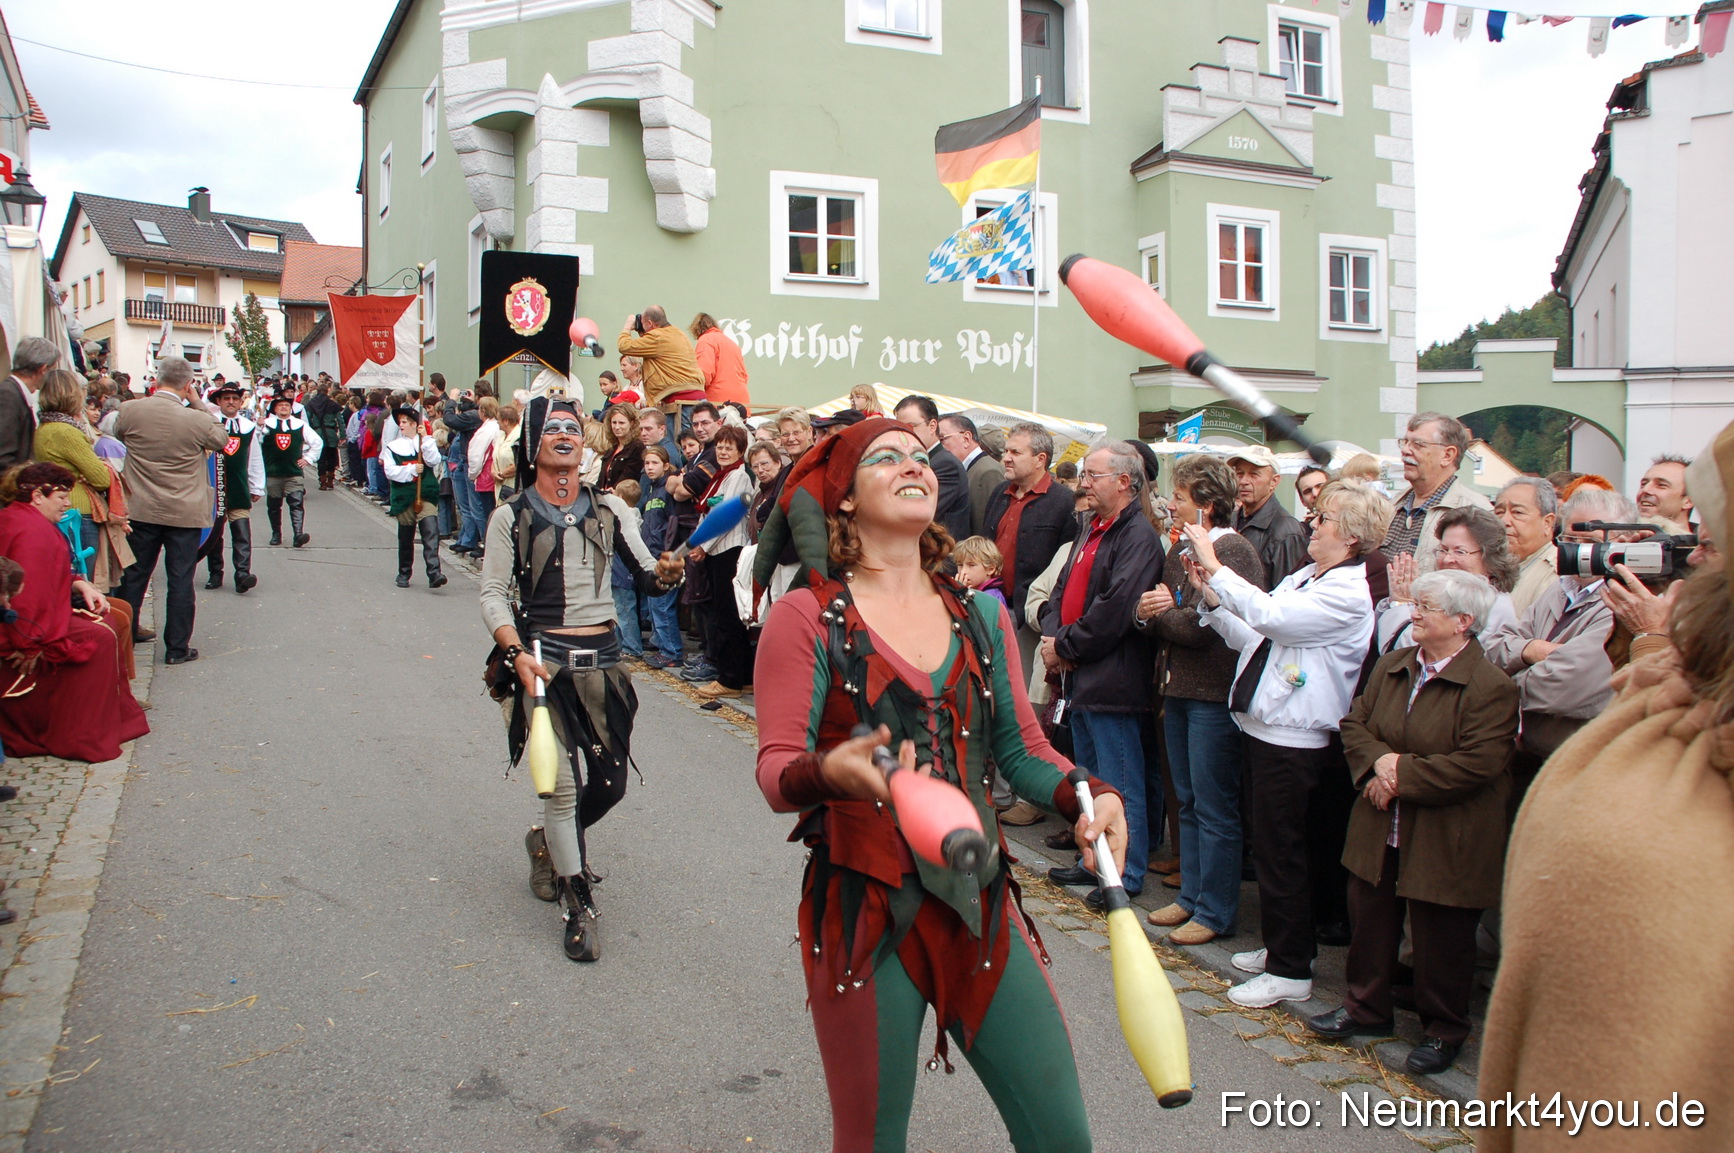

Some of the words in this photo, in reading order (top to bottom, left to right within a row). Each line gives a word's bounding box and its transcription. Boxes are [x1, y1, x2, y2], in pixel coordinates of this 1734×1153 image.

[1228, 136, 1258, 151] 1570
[879, 335, 943, 371] zur
[956, 329, 1033, 373] Post
